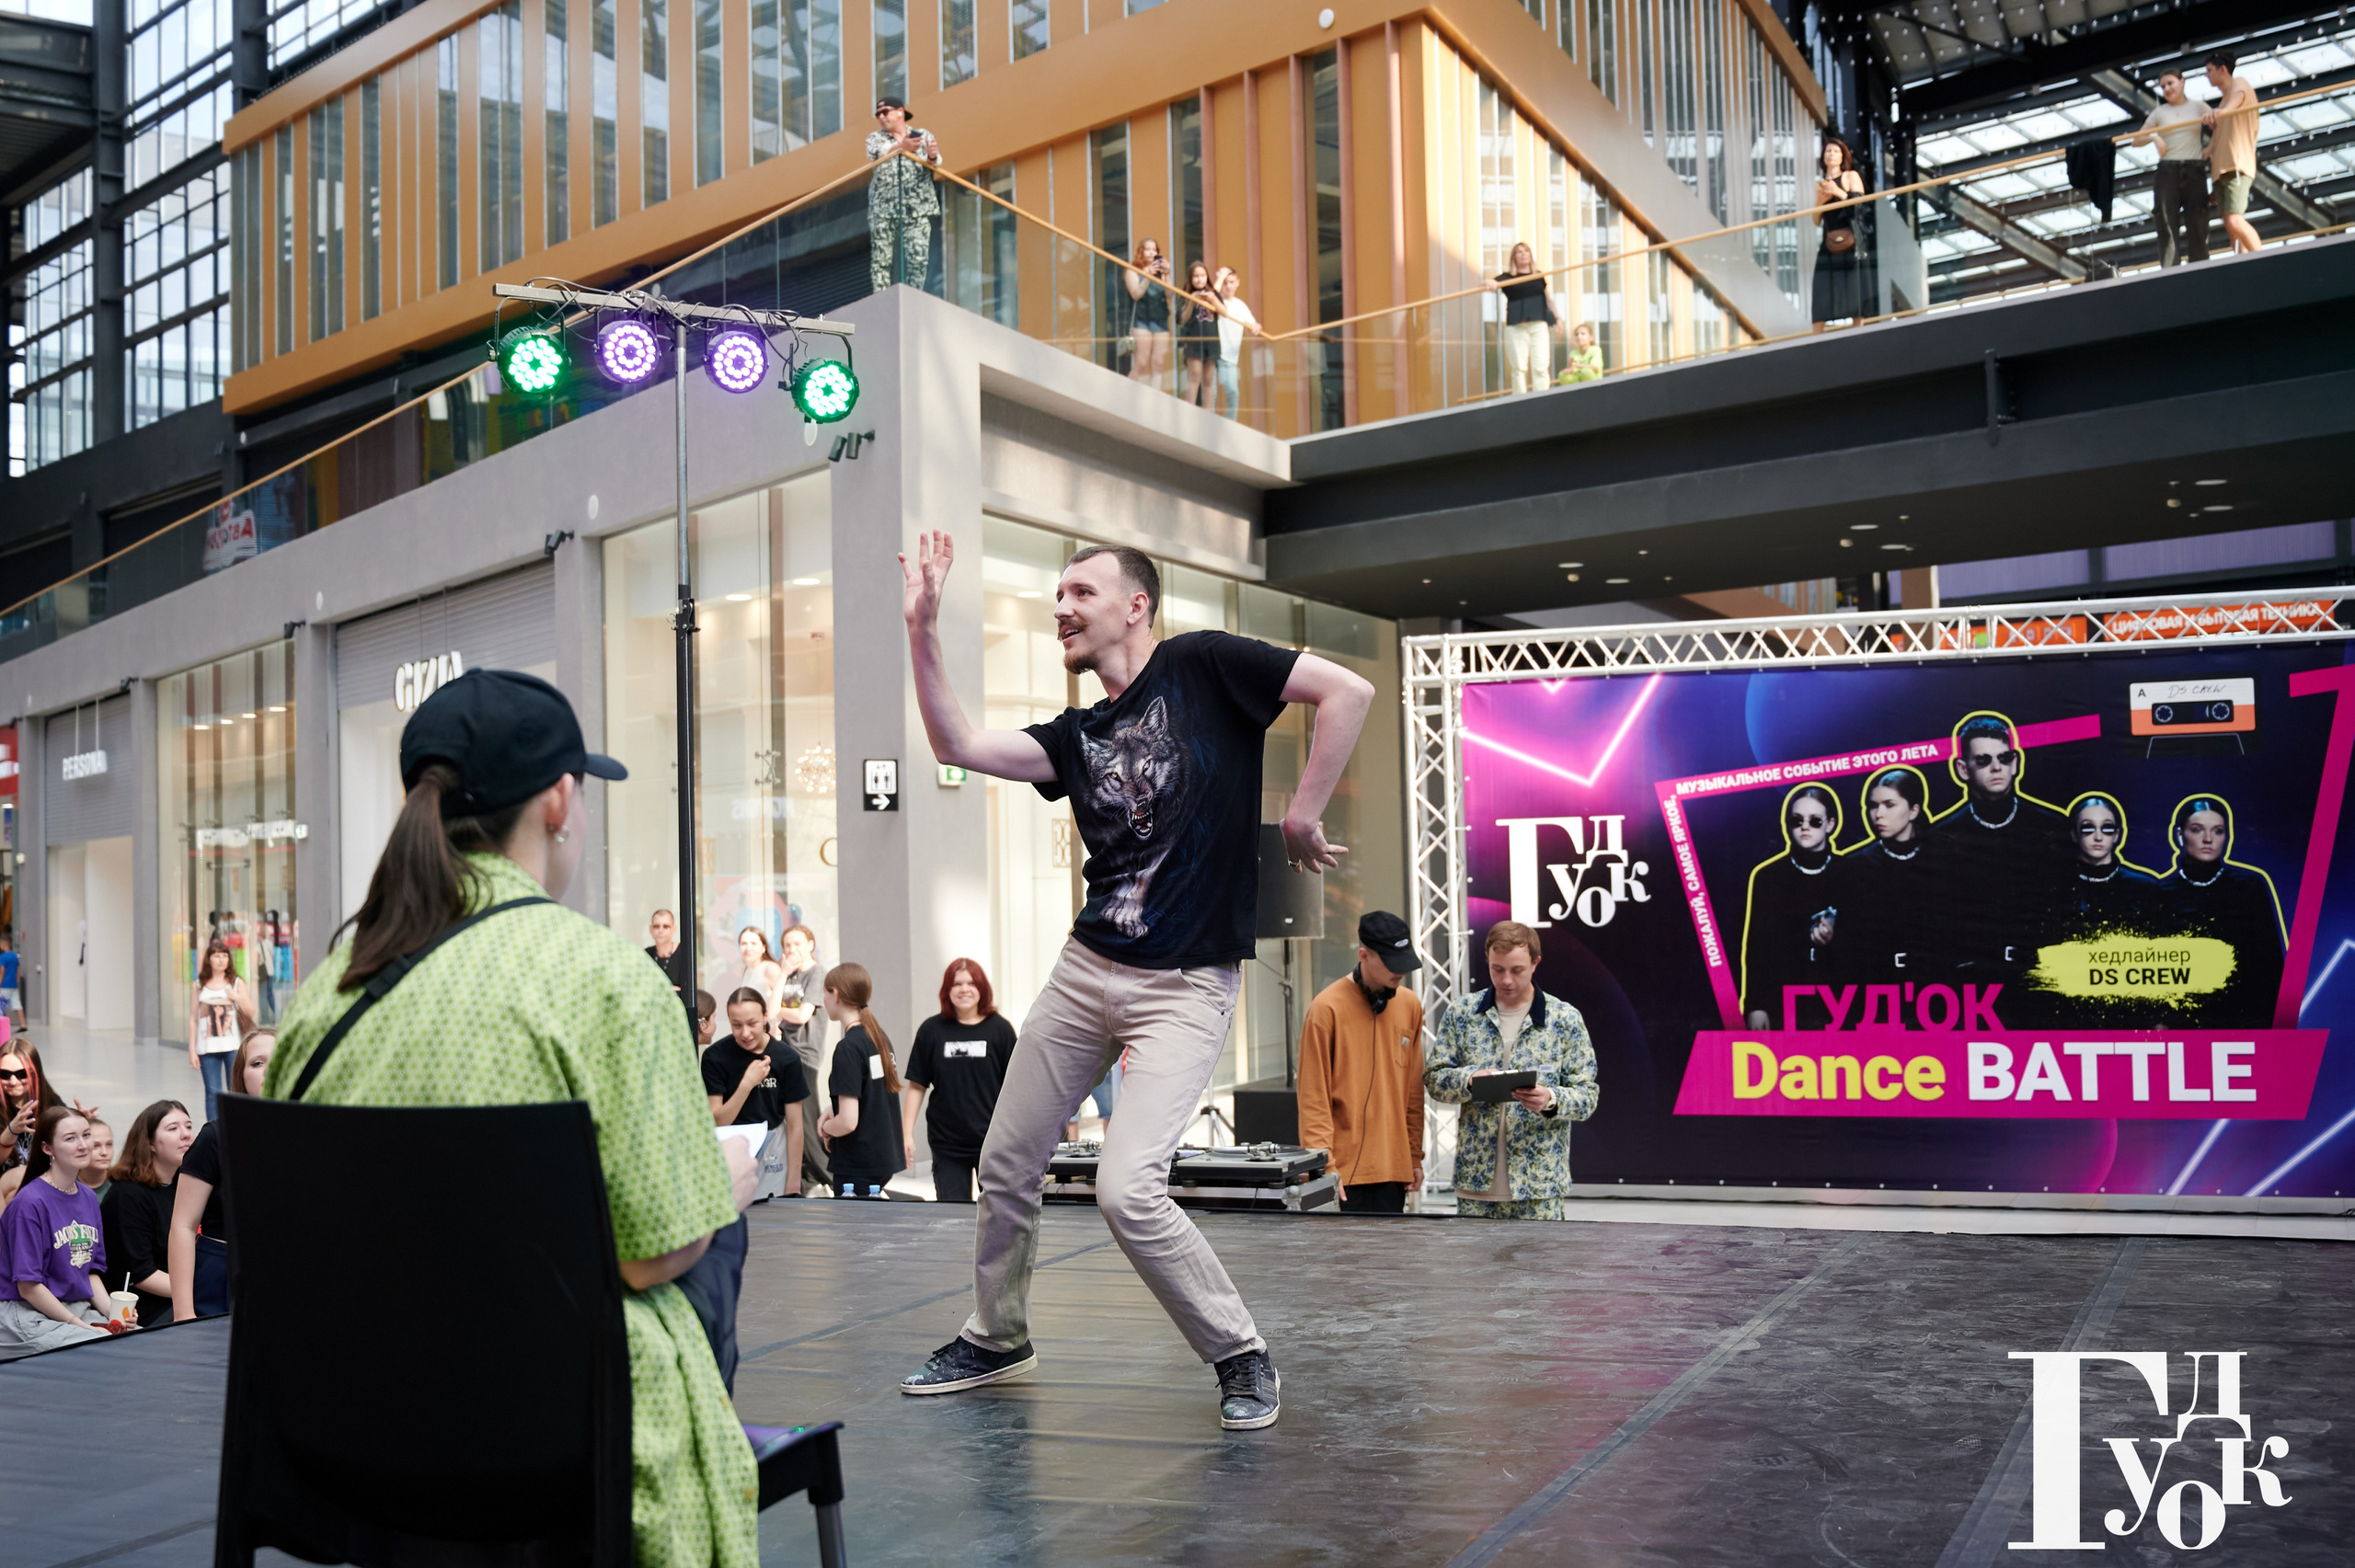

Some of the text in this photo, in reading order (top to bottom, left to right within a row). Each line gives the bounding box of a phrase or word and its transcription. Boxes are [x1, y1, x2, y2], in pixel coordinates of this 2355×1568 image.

[1676, 743, 1939, 795] МУЗЫКАЛЬНОЕ СОБЫТИЕ ЭТОГО ЛЕТА
[1664, 795, 1722, 967] ПОЖАЛУЙ, САМОЕ ЯРКОЕ,
[2088, 947, 2190, 966] хедлайнер
[2089, 967, 2190, 986] DS CREW
[1782, 981, 2007, 1031] ГУД'ОК
[1731, 1042, 2257, 1102] Dance BATTLE
